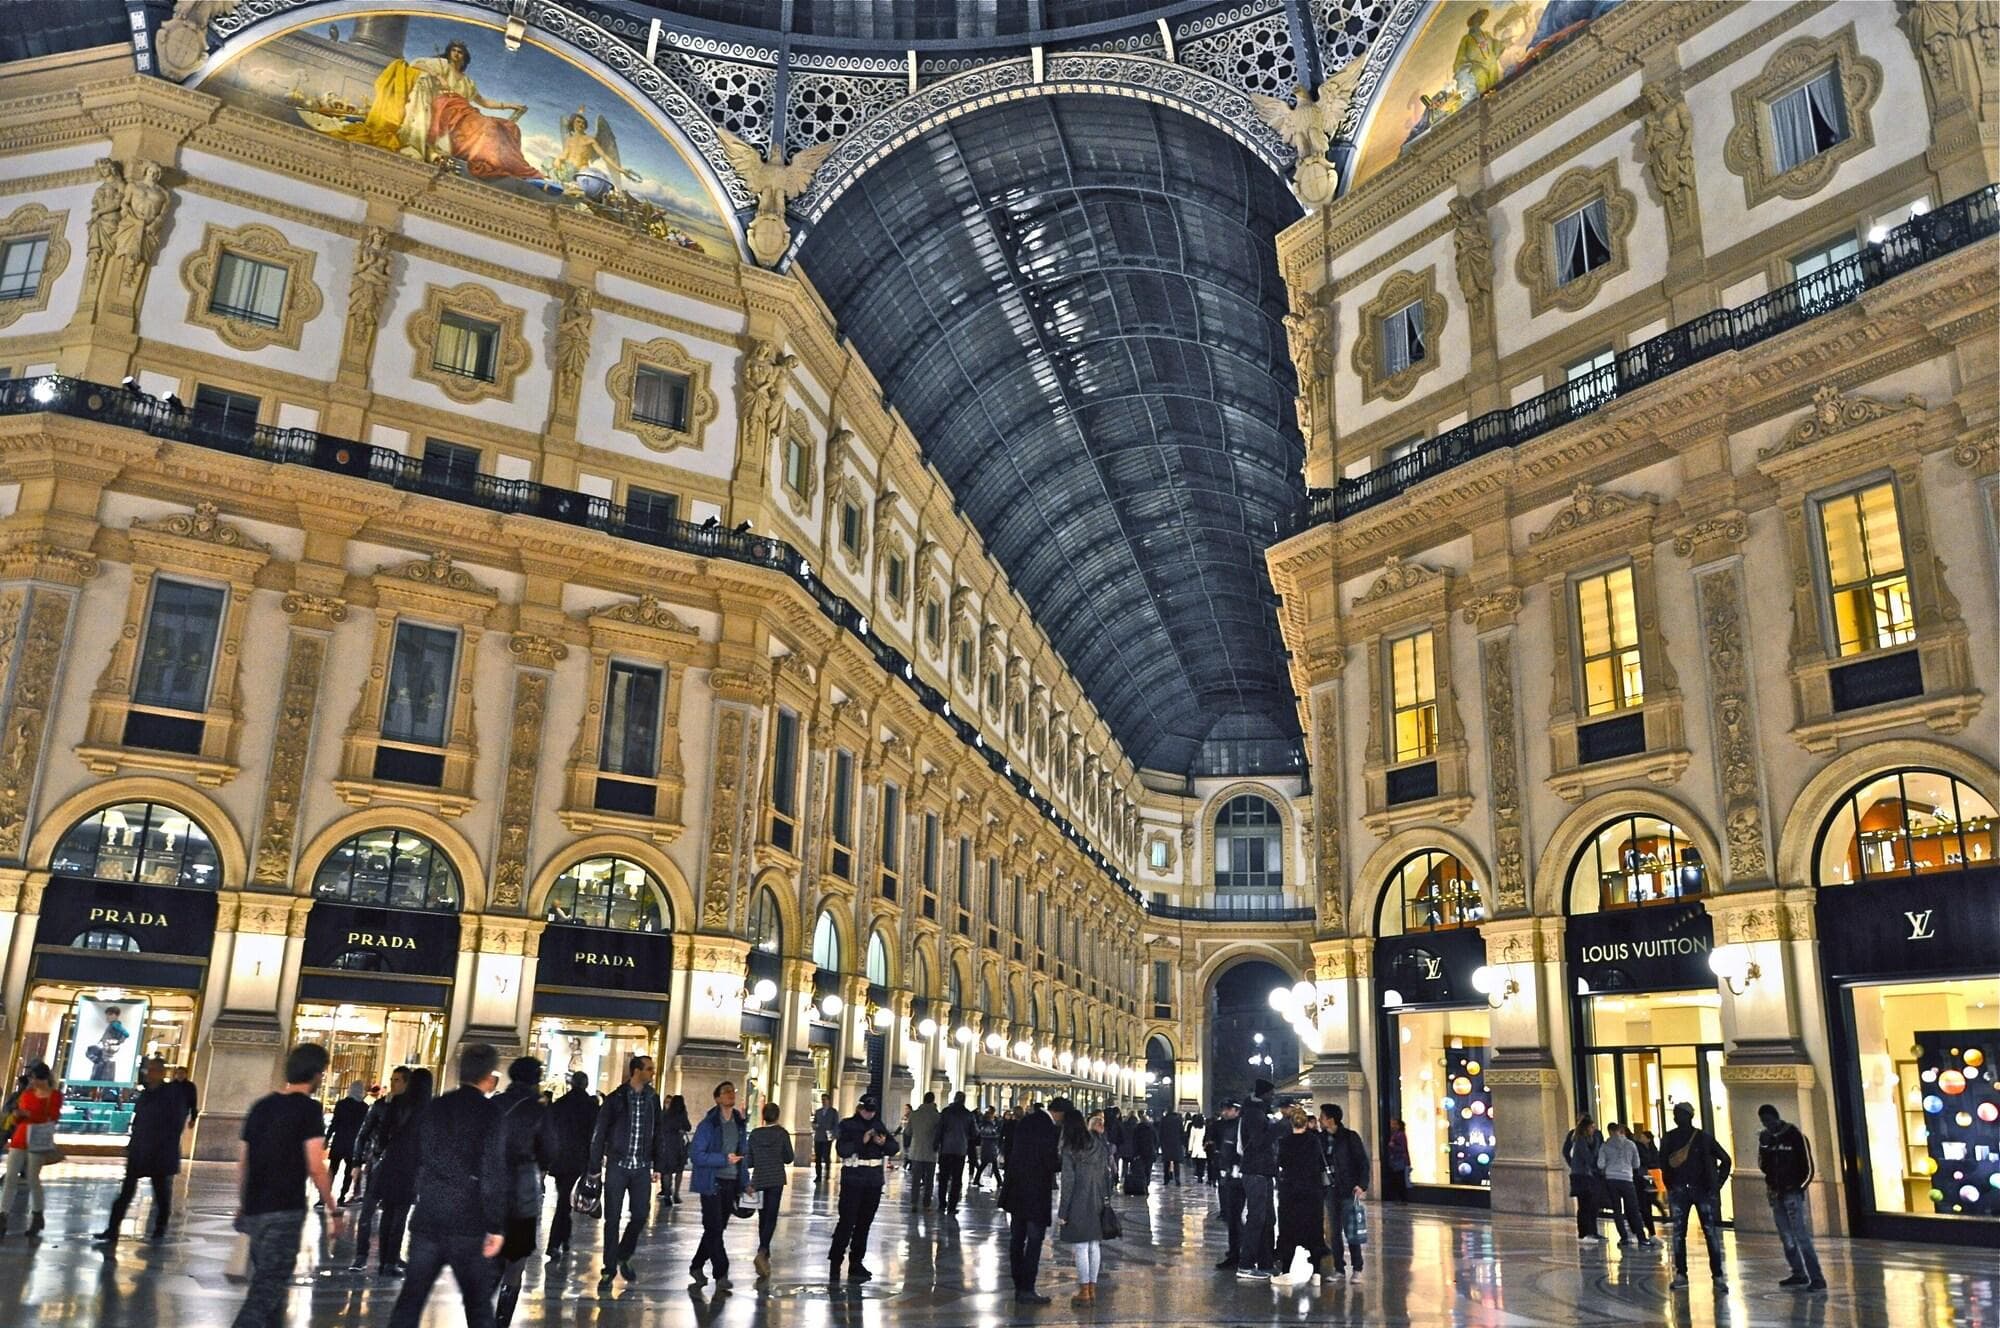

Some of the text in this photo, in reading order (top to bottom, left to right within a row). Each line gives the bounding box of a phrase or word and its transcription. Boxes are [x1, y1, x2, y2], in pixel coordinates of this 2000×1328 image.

[89, 907, 169, 928] PRADA
[347, 932, 417, 951] PRADA
[1582, 936, 1707, 963] LOUIS VUITTON
[574, 952, 636, 969] PRADA
